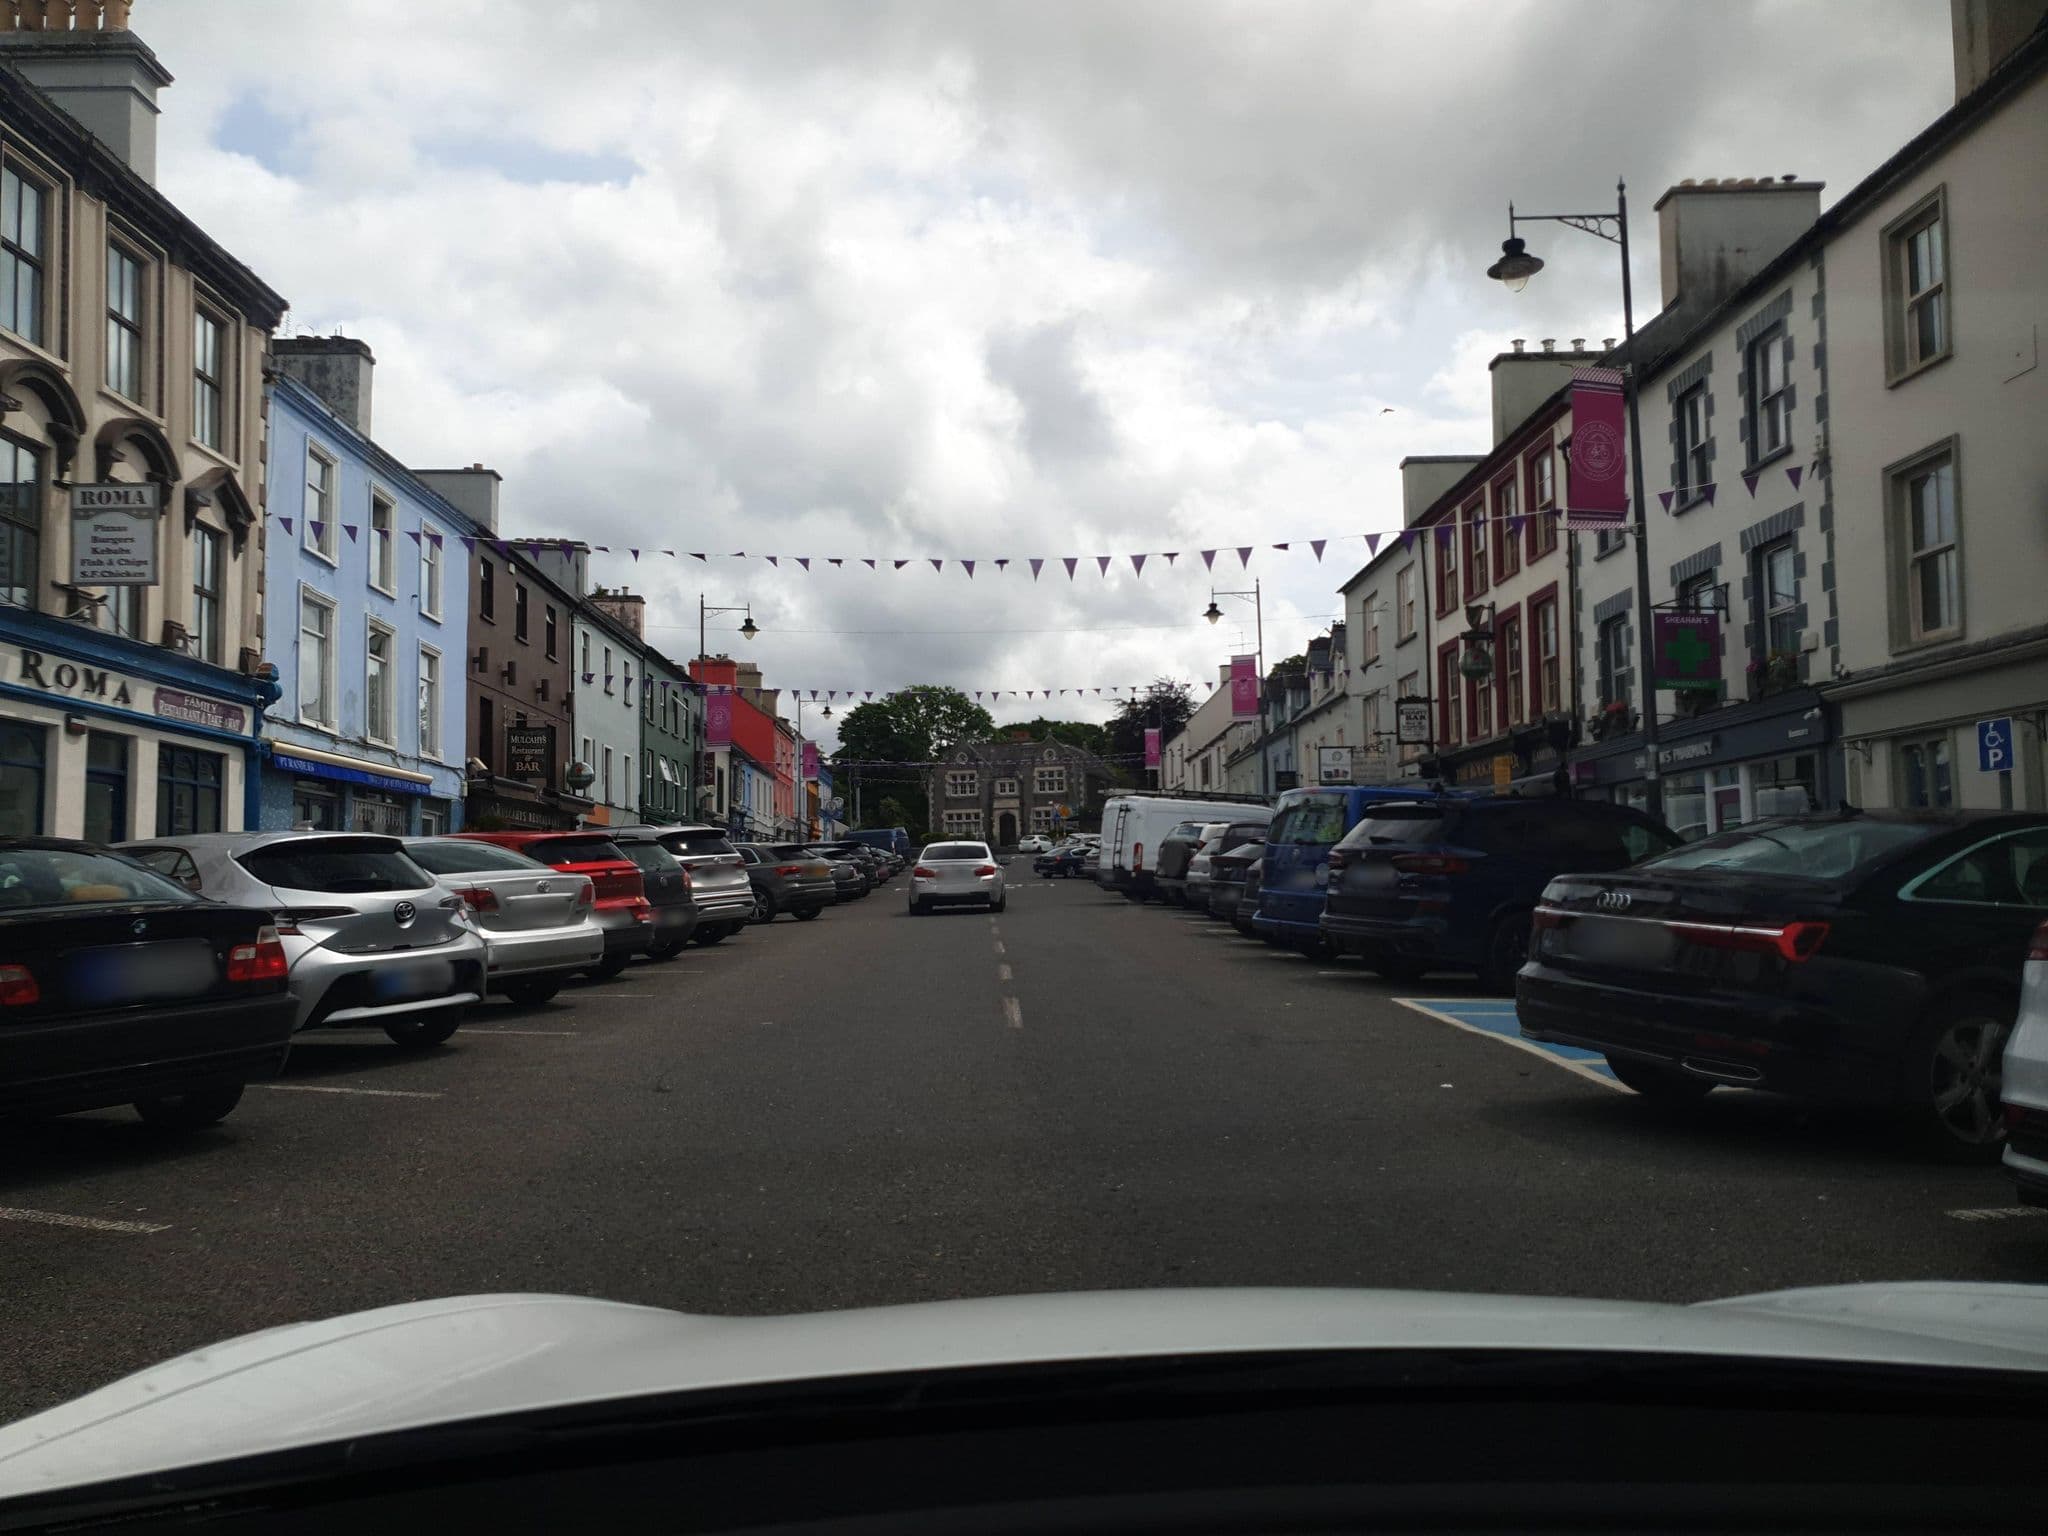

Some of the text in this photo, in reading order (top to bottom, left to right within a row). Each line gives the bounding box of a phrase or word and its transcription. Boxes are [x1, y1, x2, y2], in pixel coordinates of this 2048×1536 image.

[80, 490, 147, 505] ROMA
[90, 536, 136, 544] Burgers
[90, 547, 132, 555] Kebabs
[80, 558, 104, 567] Fish
[116, 558, 148, 567] Chips
[1663, 616, 1710, 624] SHEAHAN'S
[20, 649, 131, 704] ROMA
[184, 696, 218, 713] FAMILY
[511, 745, 545, 754] Restaurant
[1988, 749, 2003, 769] P
[515, 761, 541, 772] BAR
